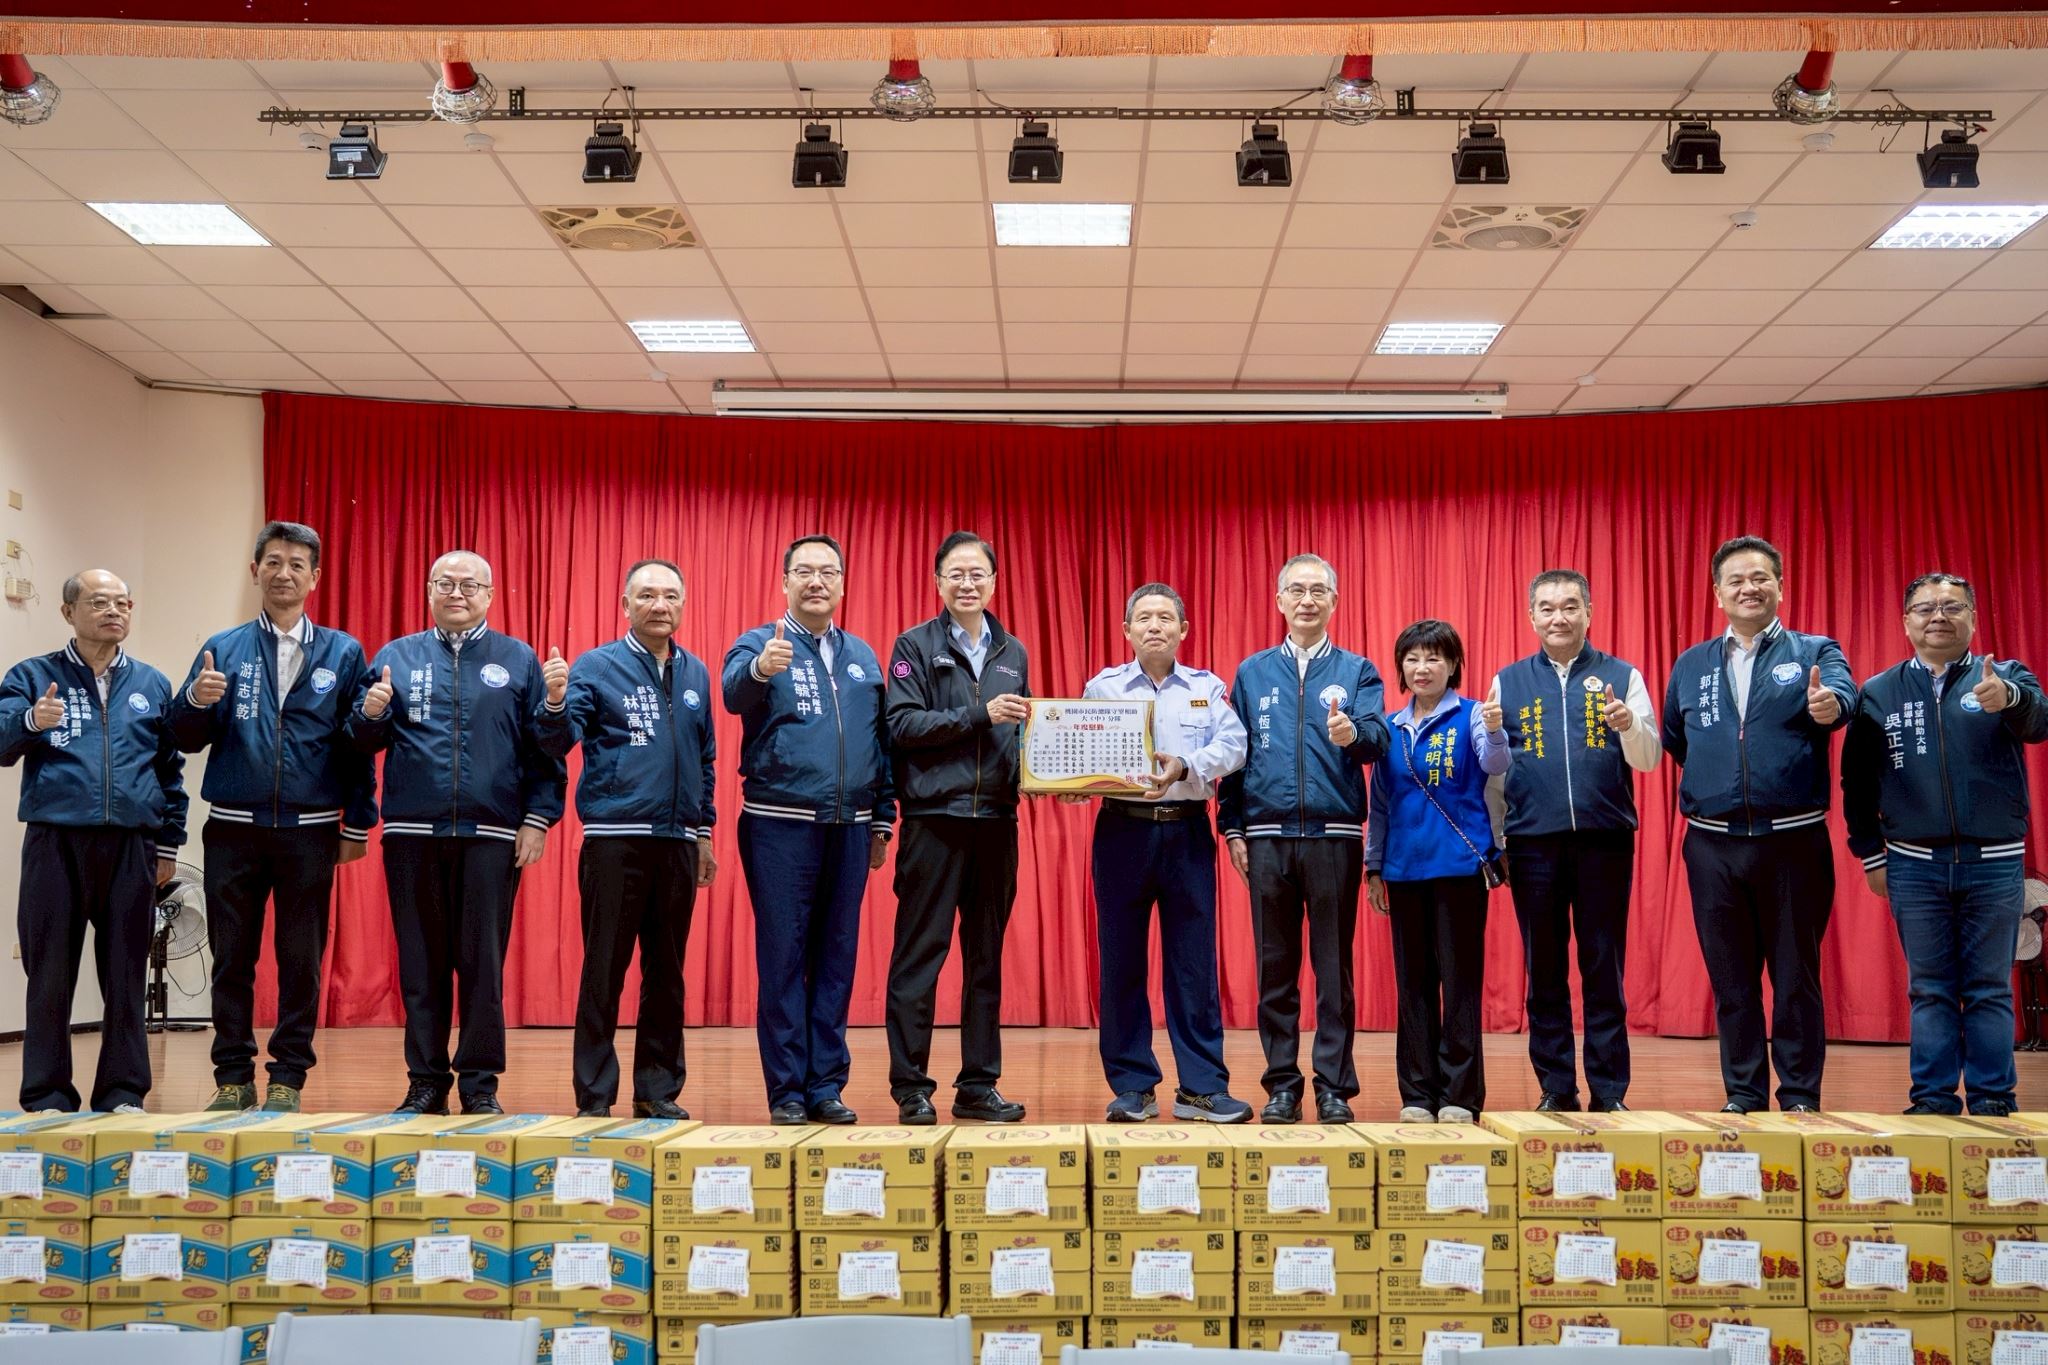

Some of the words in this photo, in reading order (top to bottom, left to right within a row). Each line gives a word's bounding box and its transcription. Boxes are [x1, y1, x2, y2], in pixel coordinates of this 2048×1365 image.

[236, 661, 254, 720] 游志乾
[408, 669, 424, 723] 陳基福
[1903, 702, 1913, 728] 指導員
[622, 694, 648, 747] 林高雄
[1884, 713, 1905, 770] 吳正吉
[1914, 701, 1927, 755] 守望相助大隊
[1425, 733, 1445, 787] 葉明月
